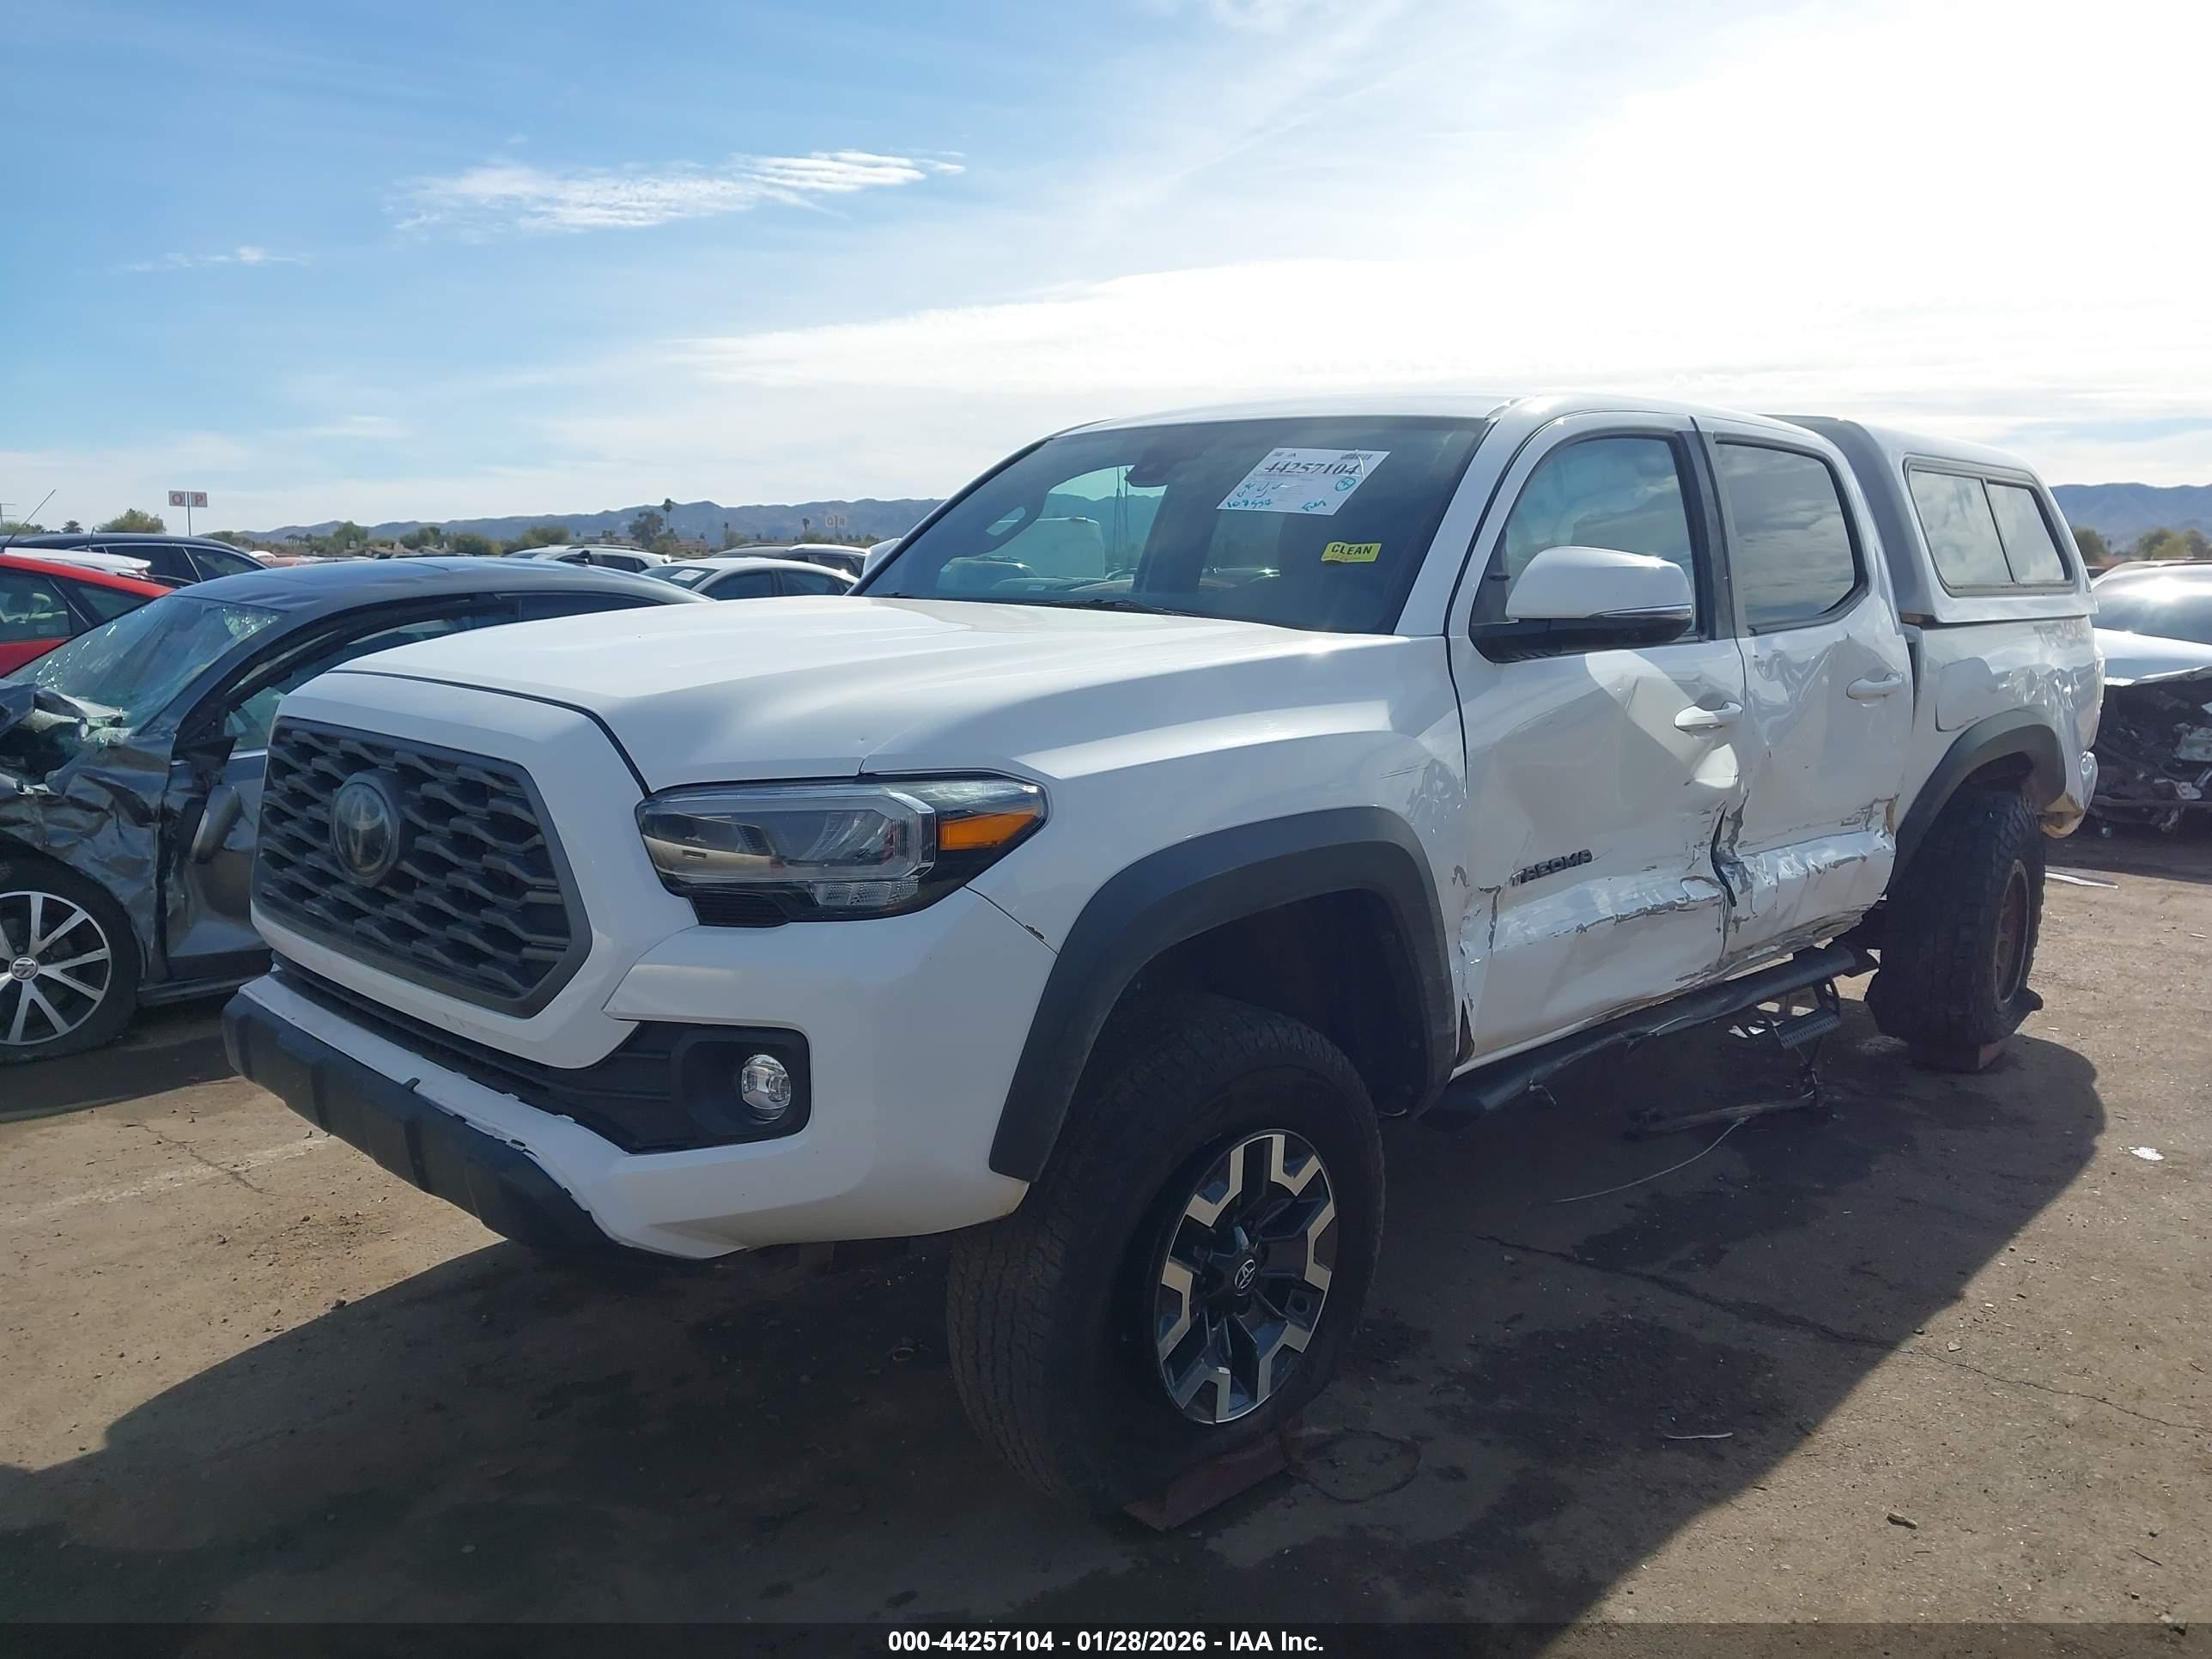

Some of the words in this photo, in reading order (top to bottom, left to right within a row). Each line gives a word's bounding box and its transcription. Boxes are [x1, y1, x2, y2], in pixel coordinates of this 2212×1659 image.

[1264, 460, 1361, 475] 44257104
[195, 494, 204, 506] P
[1331, 544, 1373, 556] CLEAN
